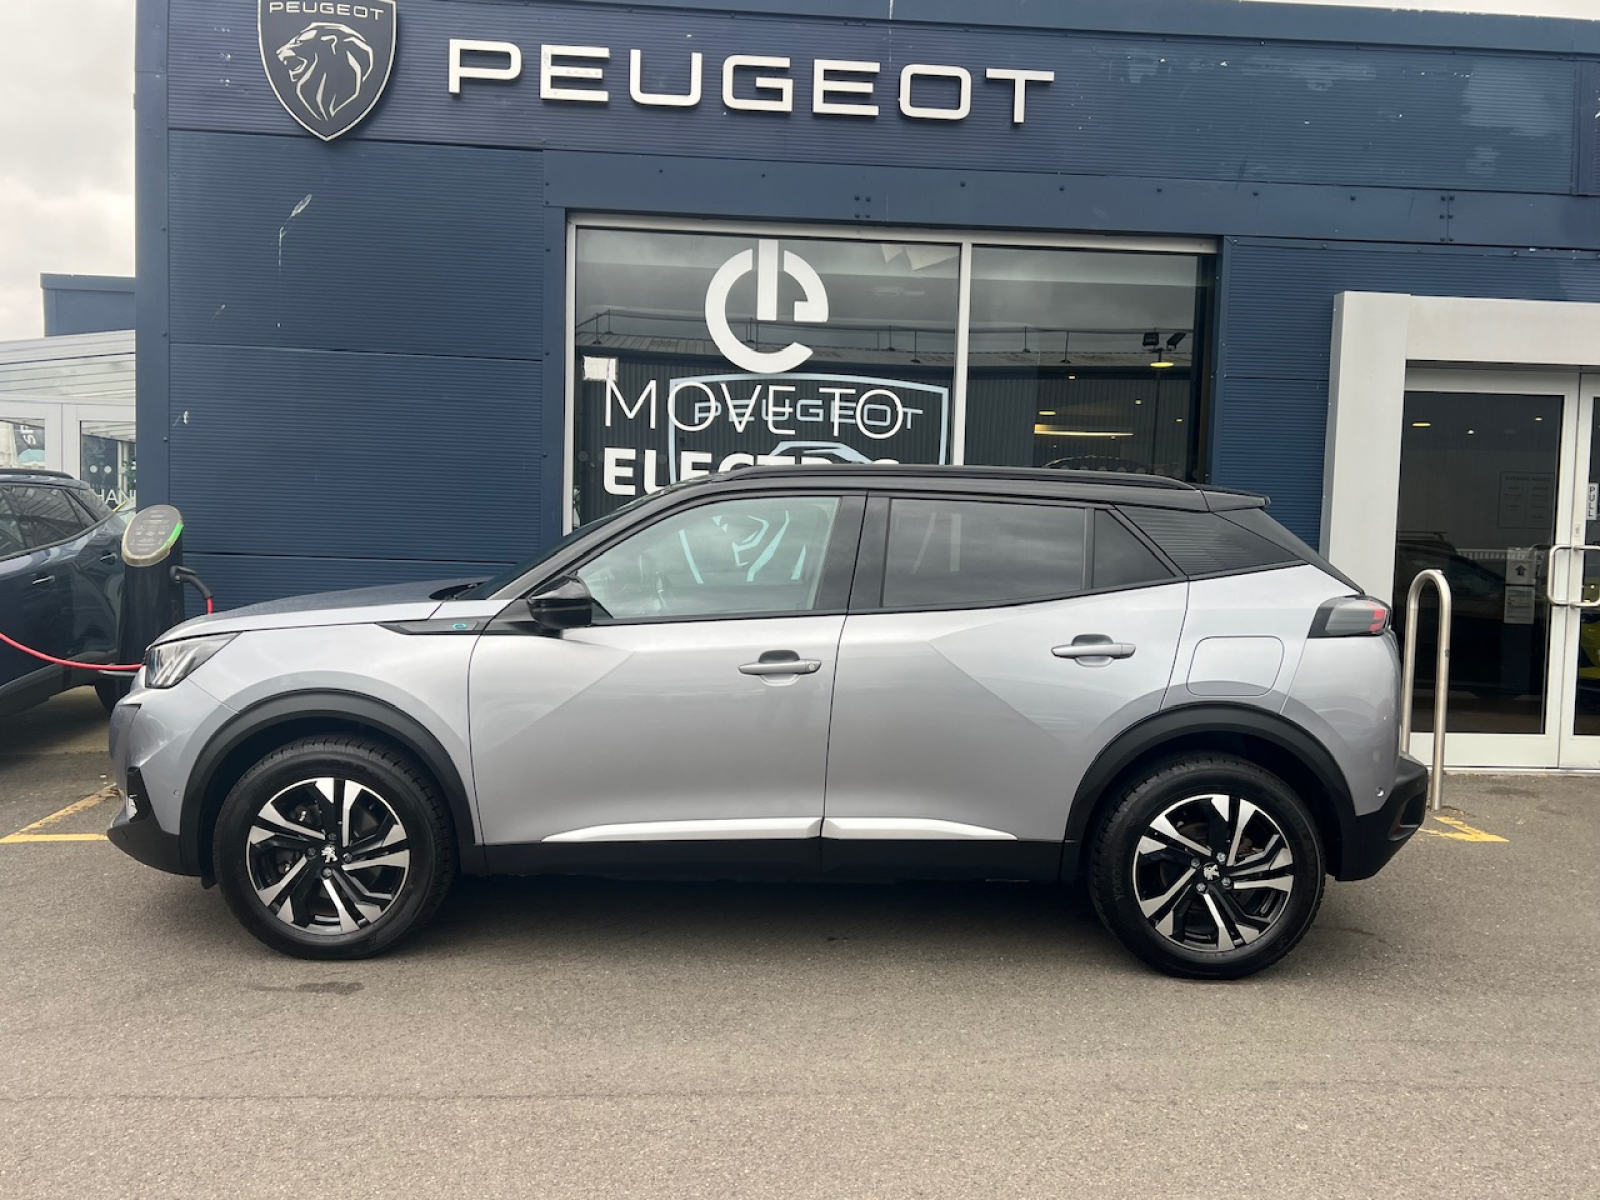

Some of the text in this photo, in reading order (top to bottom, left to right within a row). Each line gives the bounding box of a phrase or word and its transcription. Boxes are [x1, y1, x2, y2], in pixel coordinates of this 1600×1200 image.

[269, 1, 384, 20] PEUGEOT
[448, 38, 1055, 123] PEUGEOT
[604, 379, 904, 439] MOVE TO
[694, 399, 924, 429] PEUGEOT
[1588, 486, 1596, 517] PULL
